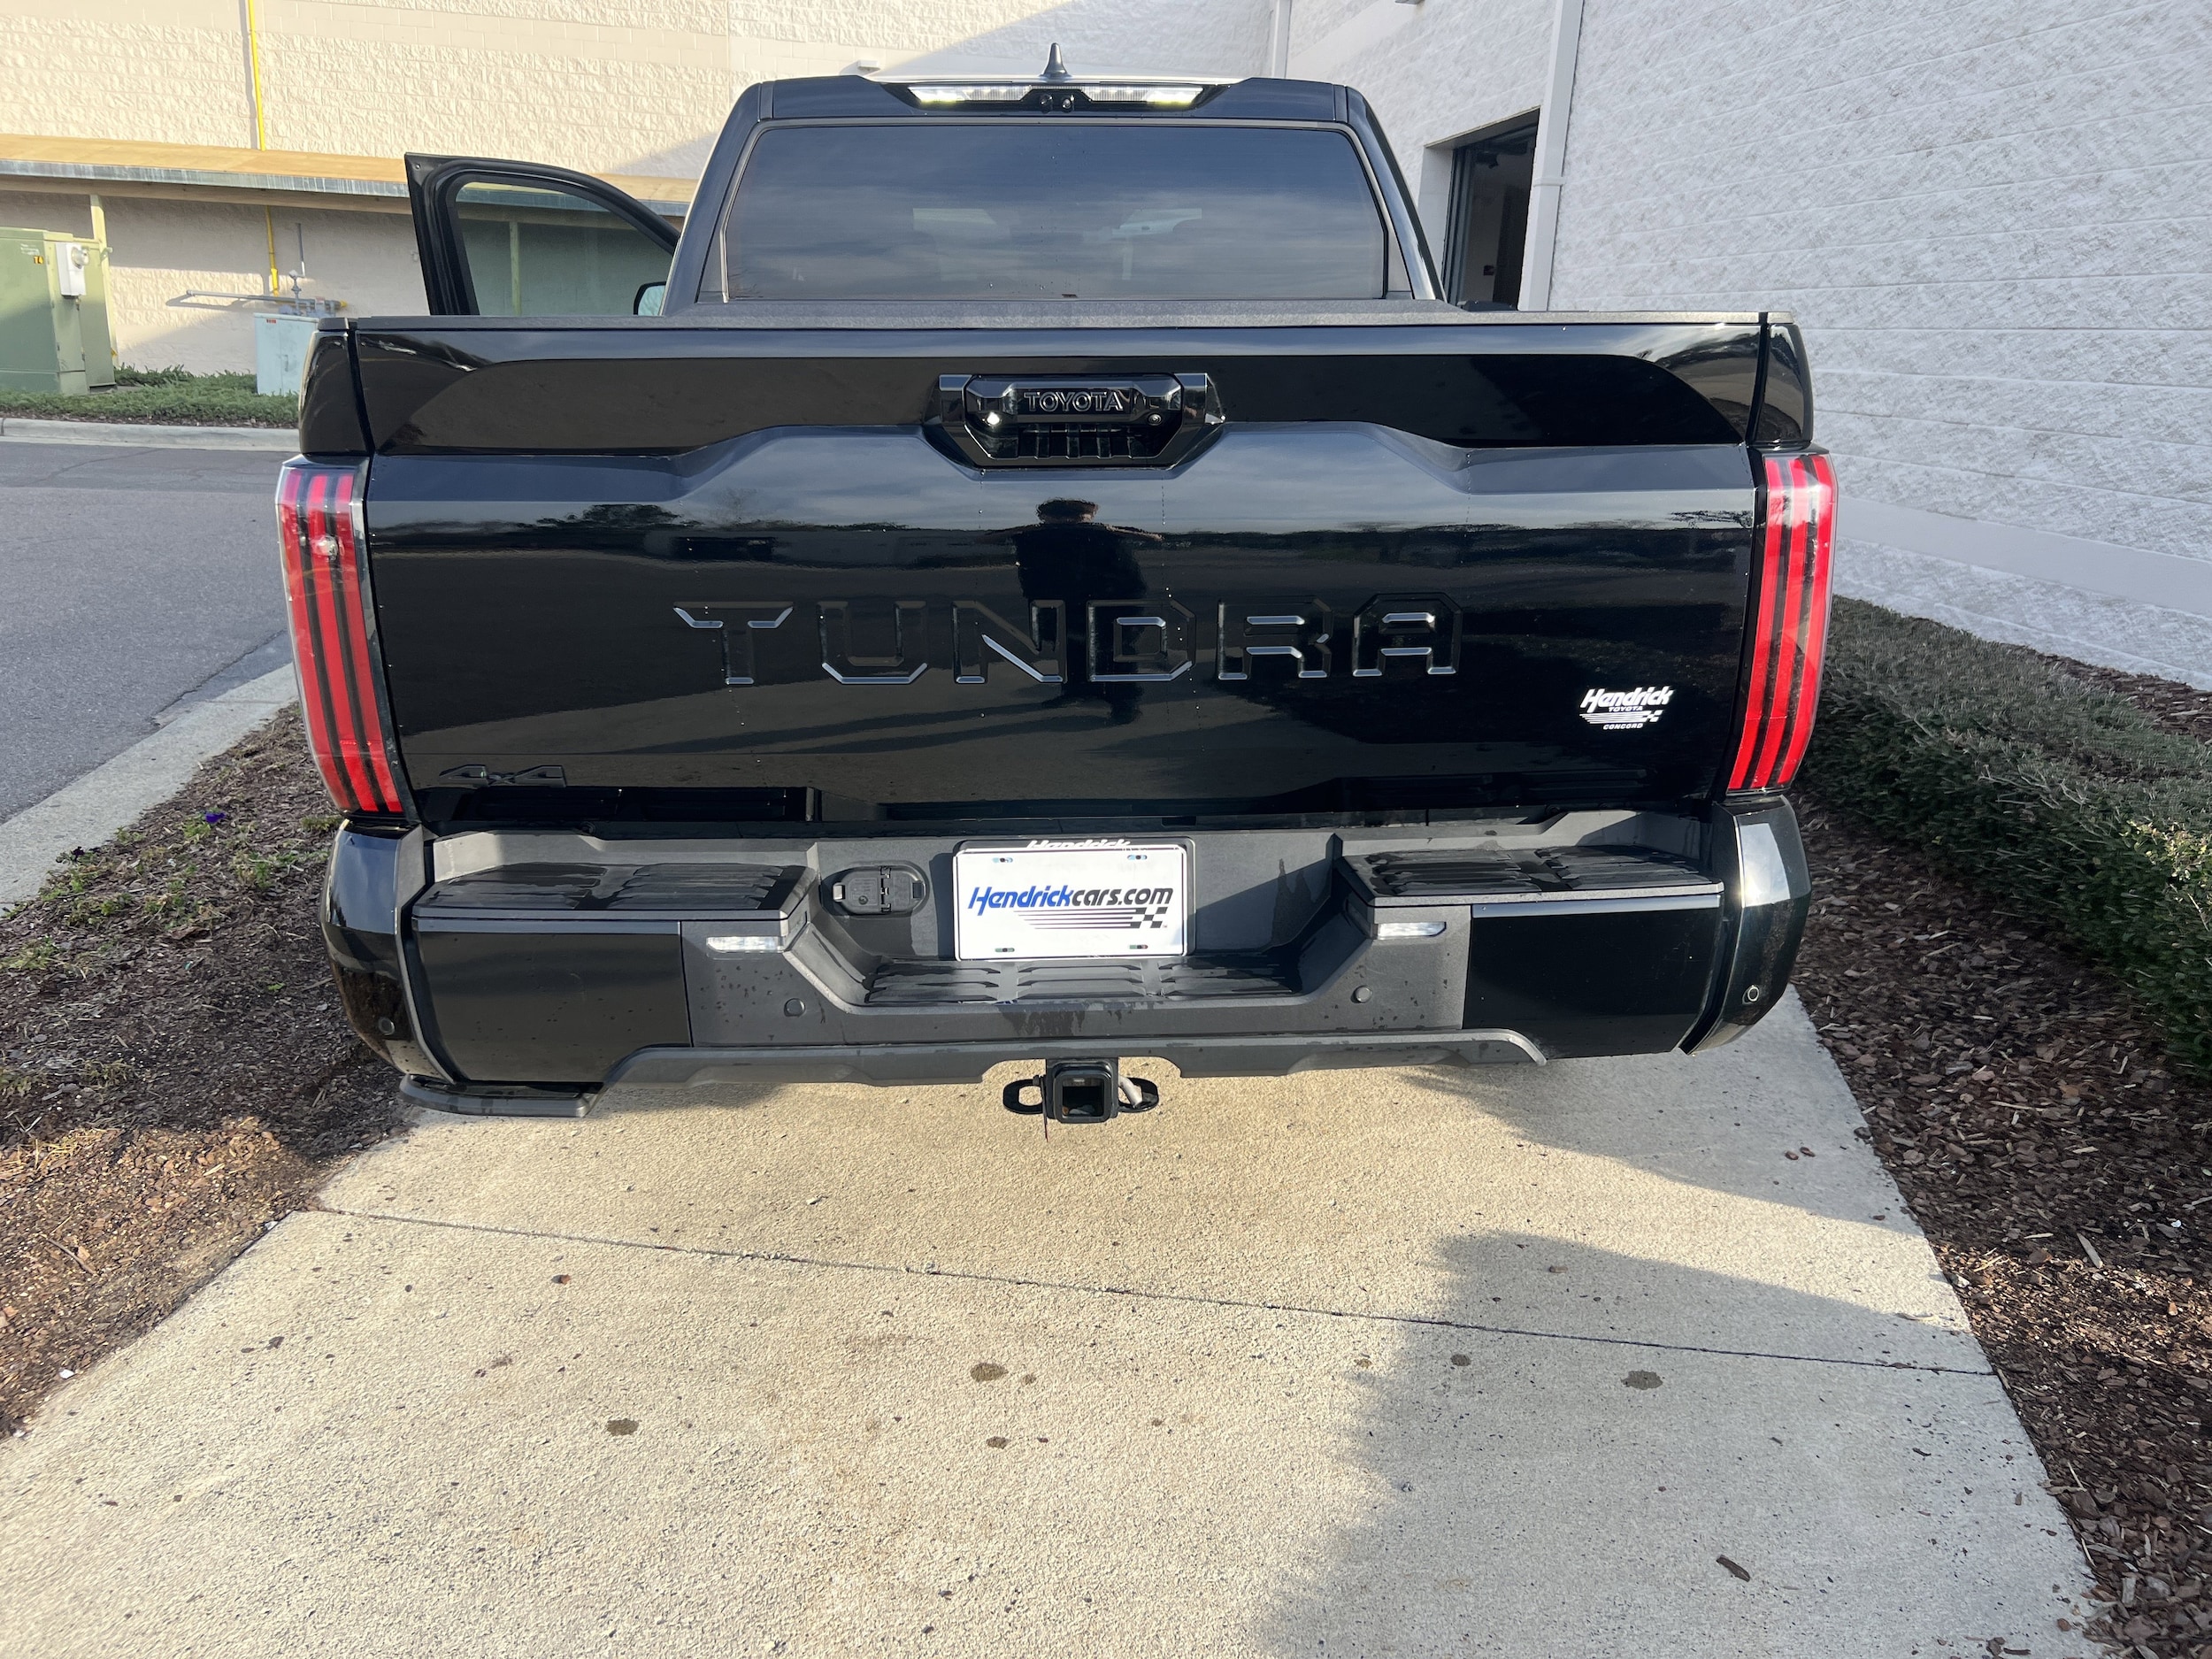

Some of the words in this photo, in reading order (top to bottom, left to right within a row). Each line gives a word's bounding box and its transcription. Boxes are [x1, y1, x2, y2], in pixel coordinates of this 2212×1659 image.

[1024, 391, 1124, 411] TOYOTA
[673, 591, 1463, 686] TUNDRA
[1579, 686, 1675, 713] Hendrick
[968, 885, 1173, 917] Hendrickcars.com
